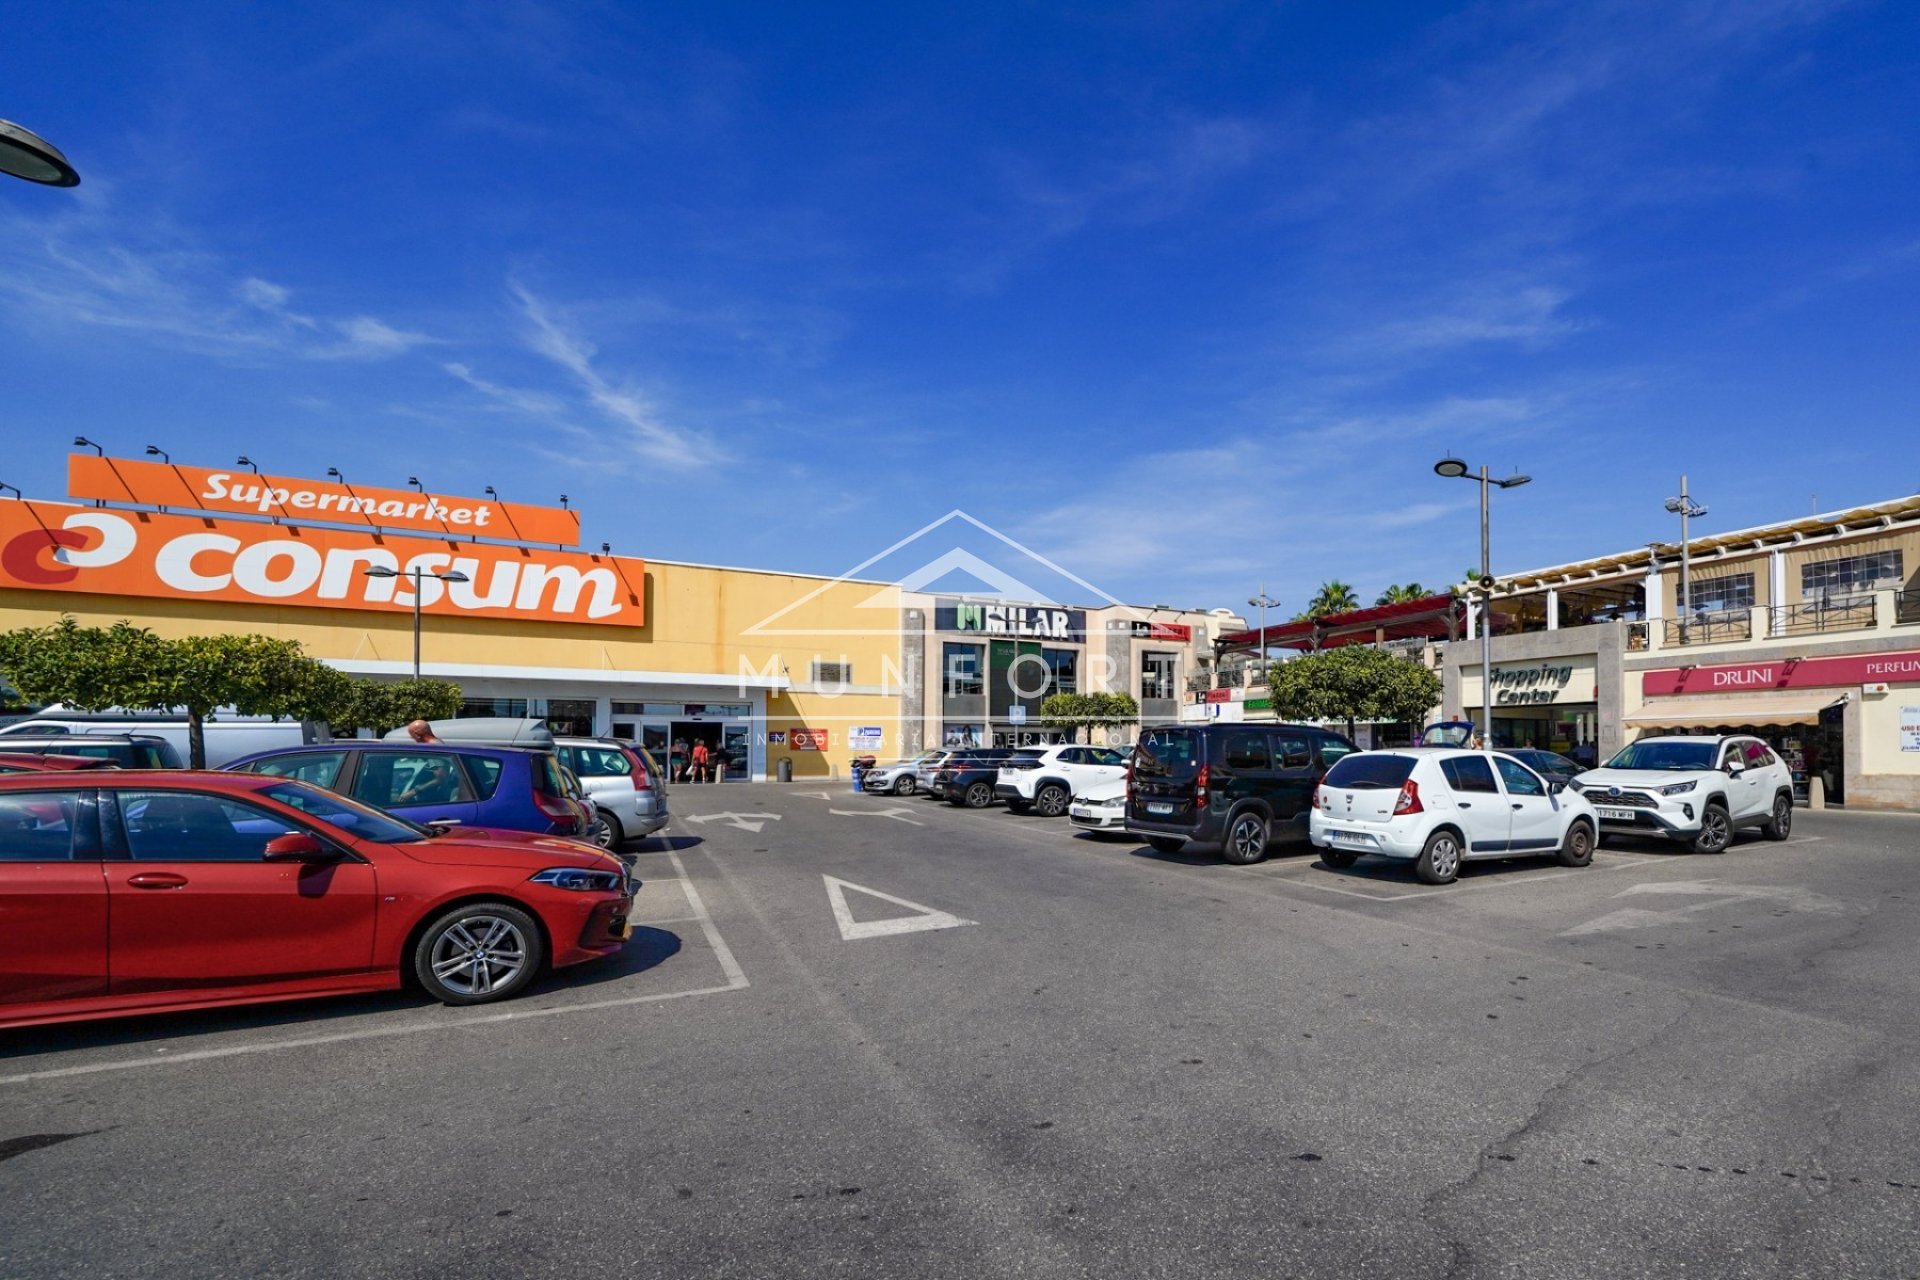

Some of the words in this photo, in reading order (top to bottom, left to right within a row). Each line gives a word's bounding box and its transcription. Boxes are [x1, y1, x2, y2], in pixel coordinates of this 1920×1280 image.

[202, 473, 491, 526] Supermarket
[155, 533, 622, 619] consum
[985, 605, 1069, 638] MILAR
[1713, 668, 1772, 686] DRUNI
[1496, 688, 1559, 704] Center
